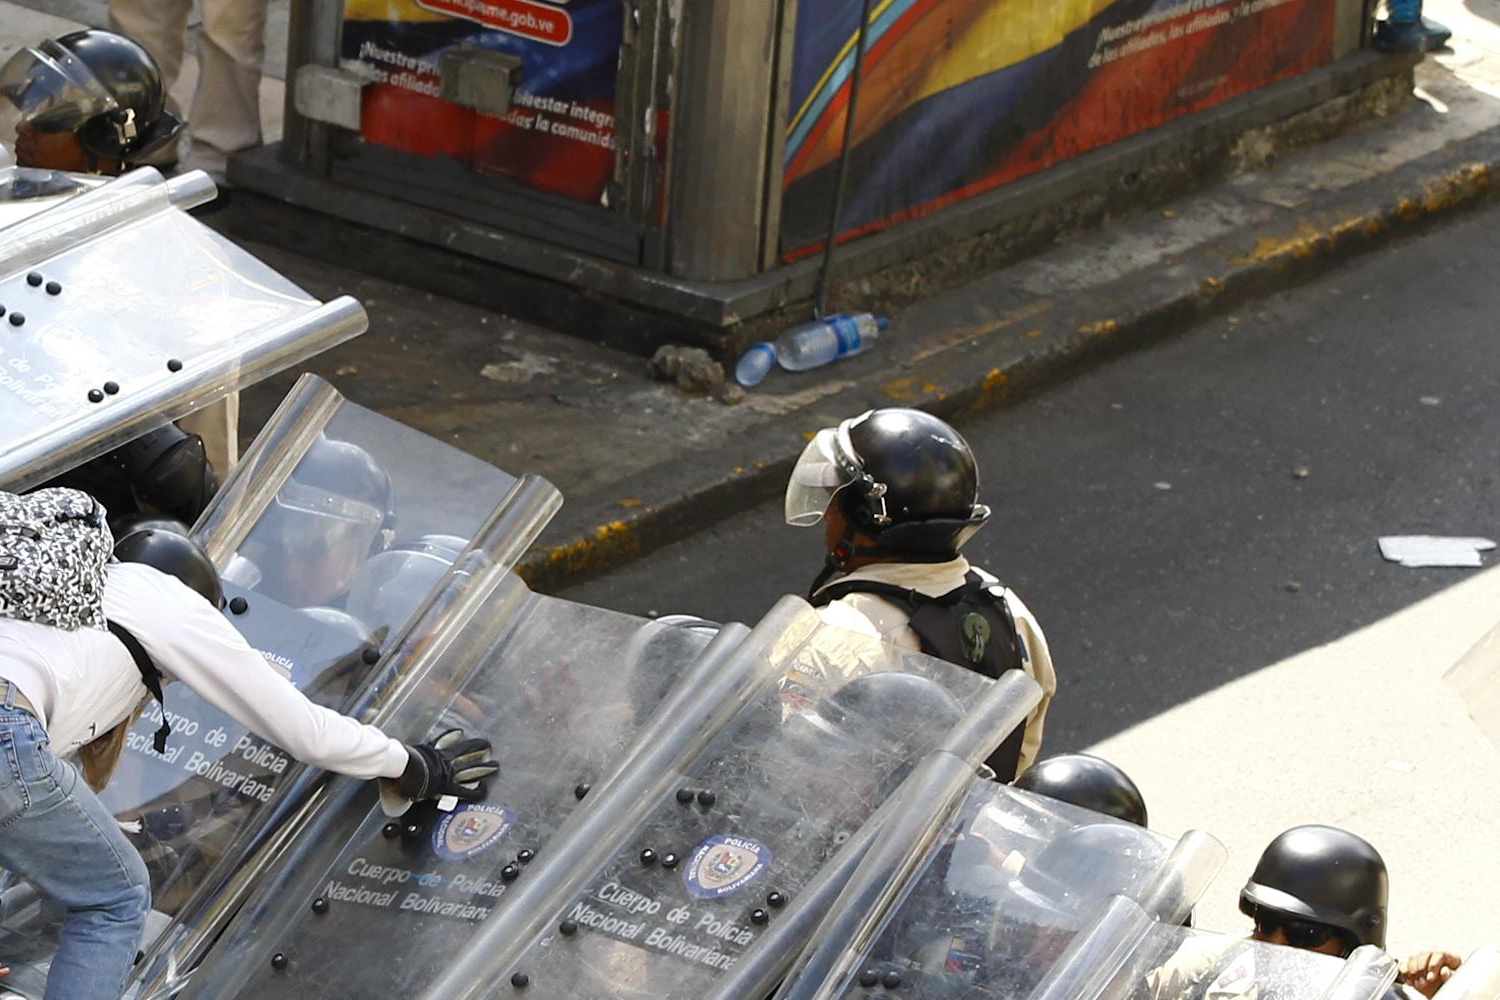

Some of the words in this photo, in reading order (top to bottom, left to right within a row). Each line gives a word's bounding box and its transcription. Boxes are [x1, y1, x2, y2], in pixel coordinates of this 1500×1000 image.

[204, 727, 227, 748] de
[184, 752, 275, 802] Bolivariana
[348, 858, 411, 885] Cuerpo
[418, 871, 442, 888] de
[321, 880, 398, 907] Nacional
[598, 882, 661, 915] Cuerpo
[666, 905, 690, 924] de
[567, 902, 645, 939] Nacional
